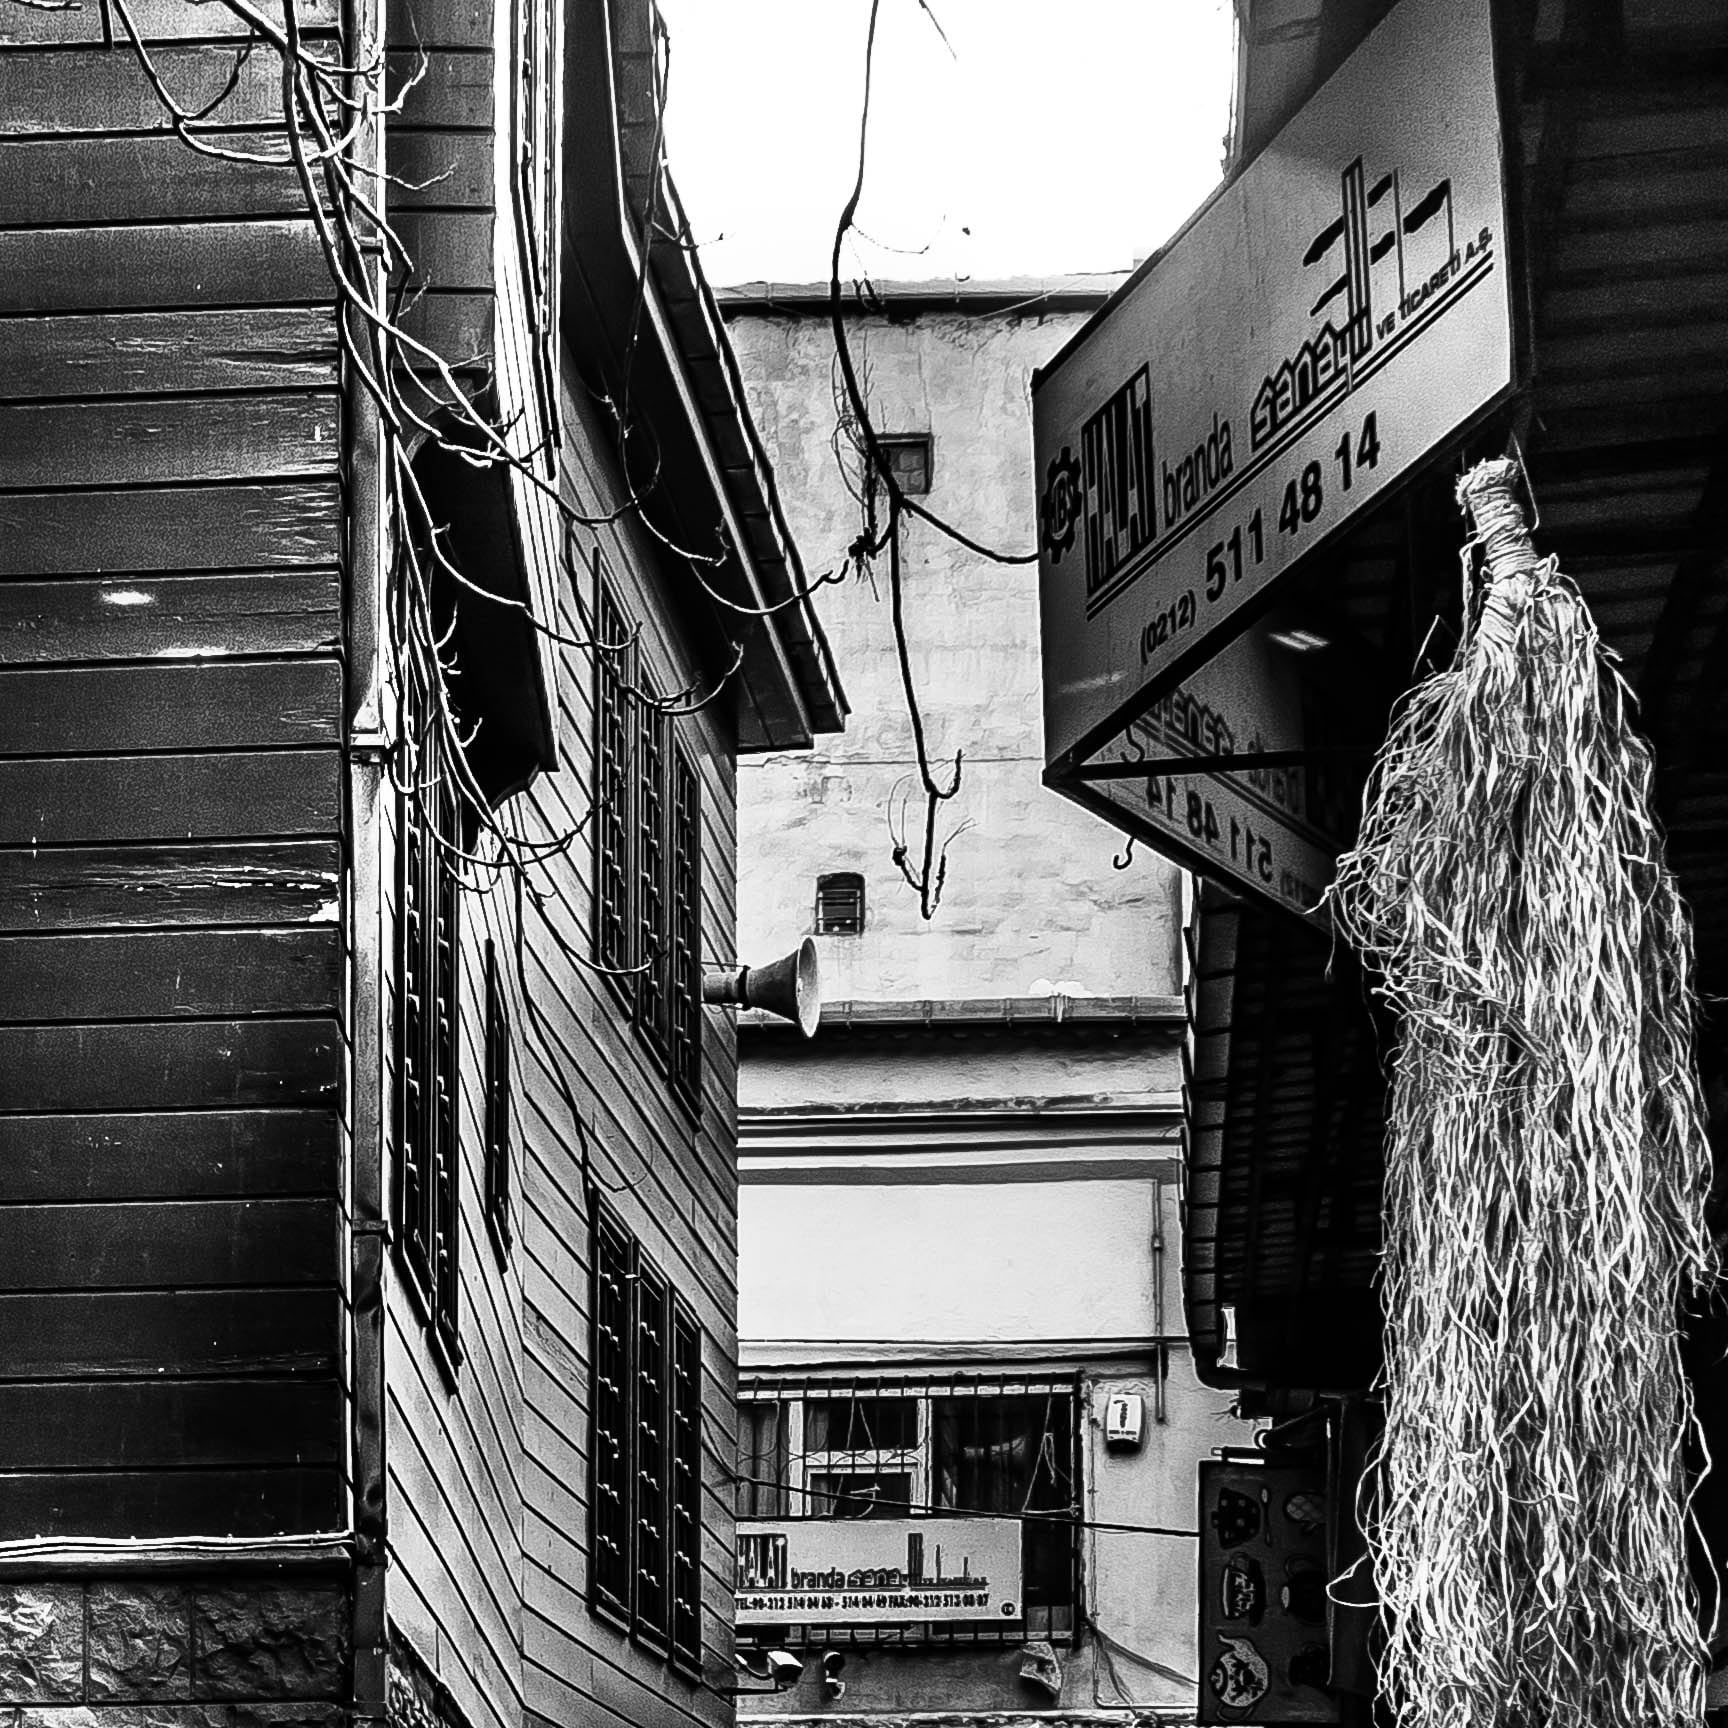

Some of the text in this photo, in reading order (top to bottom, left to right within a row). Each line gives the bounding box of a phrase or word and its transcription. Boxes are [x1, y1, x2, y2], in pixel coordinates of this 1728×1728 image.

[1083, 363, 1156, 597] HALAT
[1161, 411, 1234, 529] branda
[1376, 310, 1396, 340] VE
[1140, 410, 1381, 666] (0212) 511 48 14
[791, 1566, 845, 1589] branda
